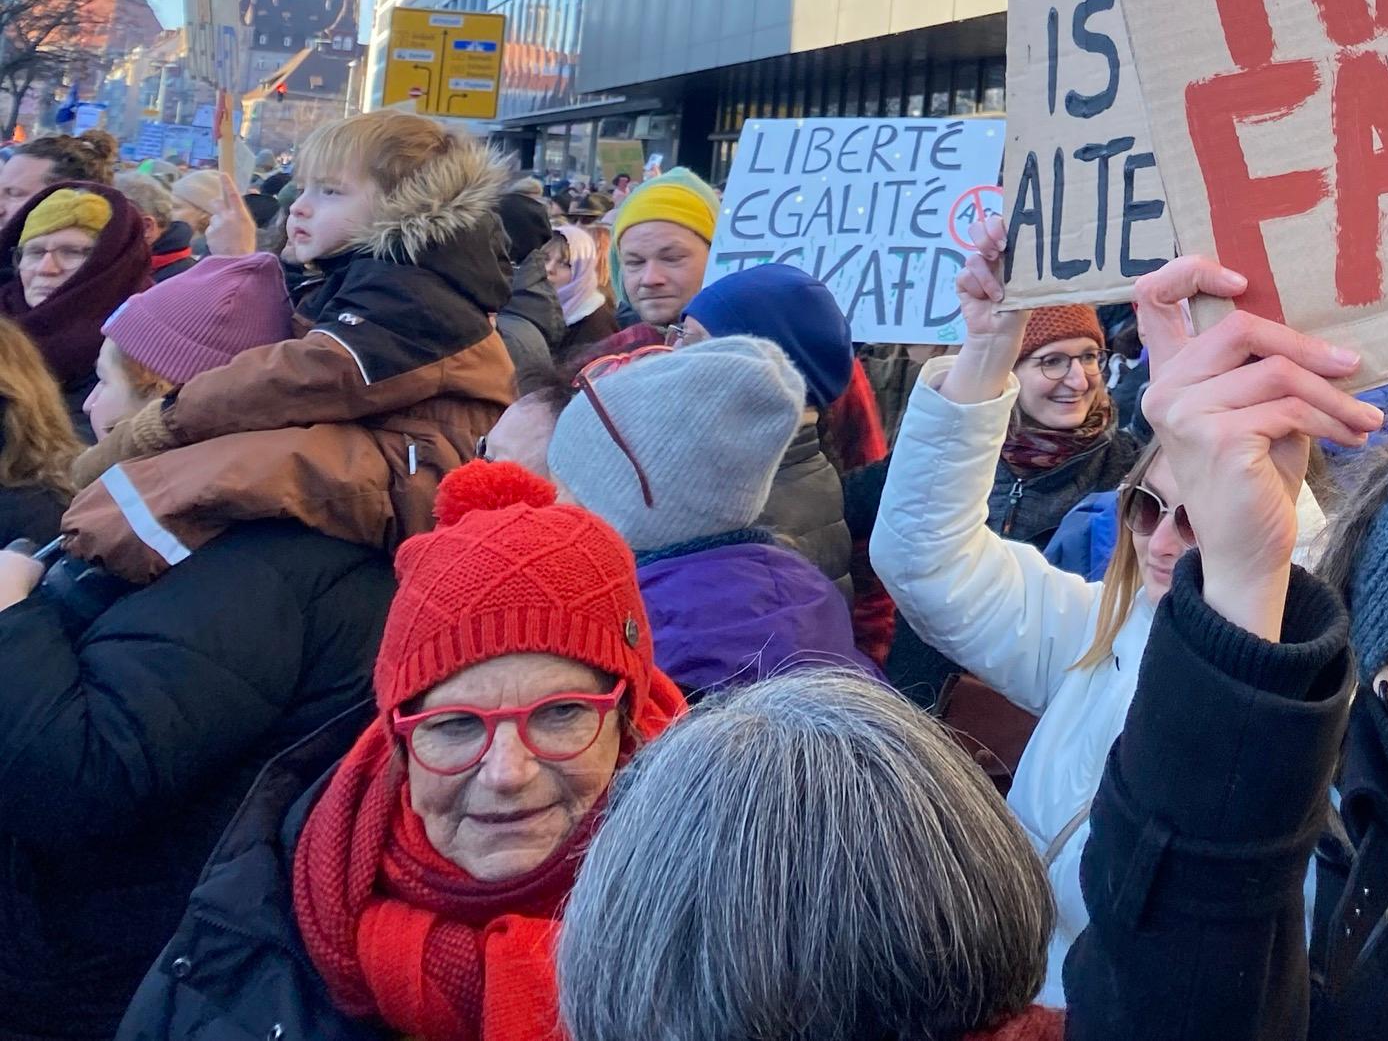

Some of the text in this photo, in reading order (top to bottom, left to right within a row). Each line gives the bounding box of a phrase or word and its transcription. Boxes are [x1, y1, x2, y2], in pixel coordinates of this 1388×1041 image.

[748, 121, 964, 174] LIBERTÉ
[730, 177, 946, 239] EGALITÉ
[1003, 136, 1170, 282] ALTE
